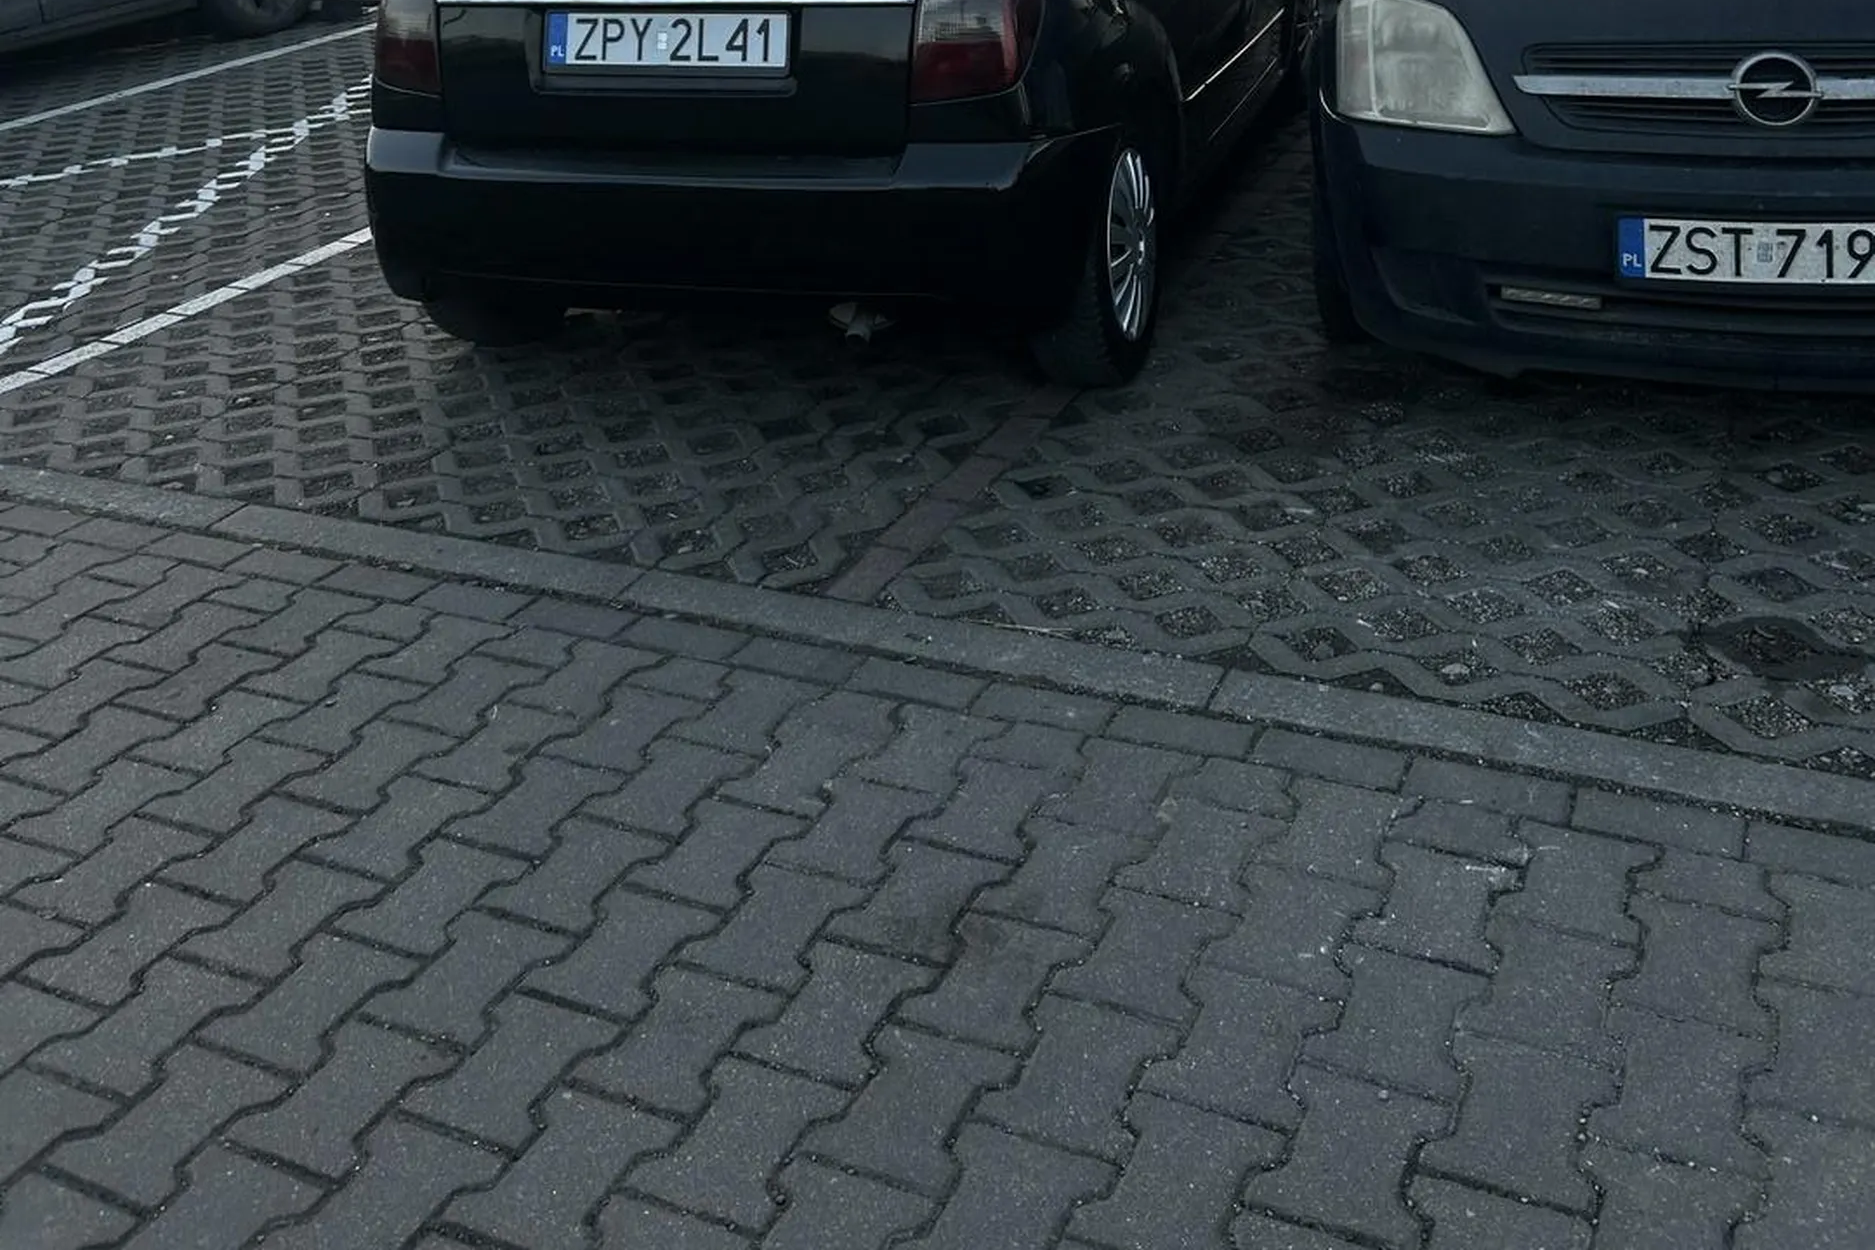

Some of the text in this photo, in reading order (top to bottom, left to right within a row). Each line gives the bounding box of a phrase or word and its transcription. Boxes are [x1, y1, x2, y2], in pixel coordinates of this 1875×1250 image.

[550, 45, 565, 58] PL
[574, 18, 772, 63] ZPY 2L41
[1622, 252, 1643, 269] PL
[1649, 224, 1875, 280] ZST 719
